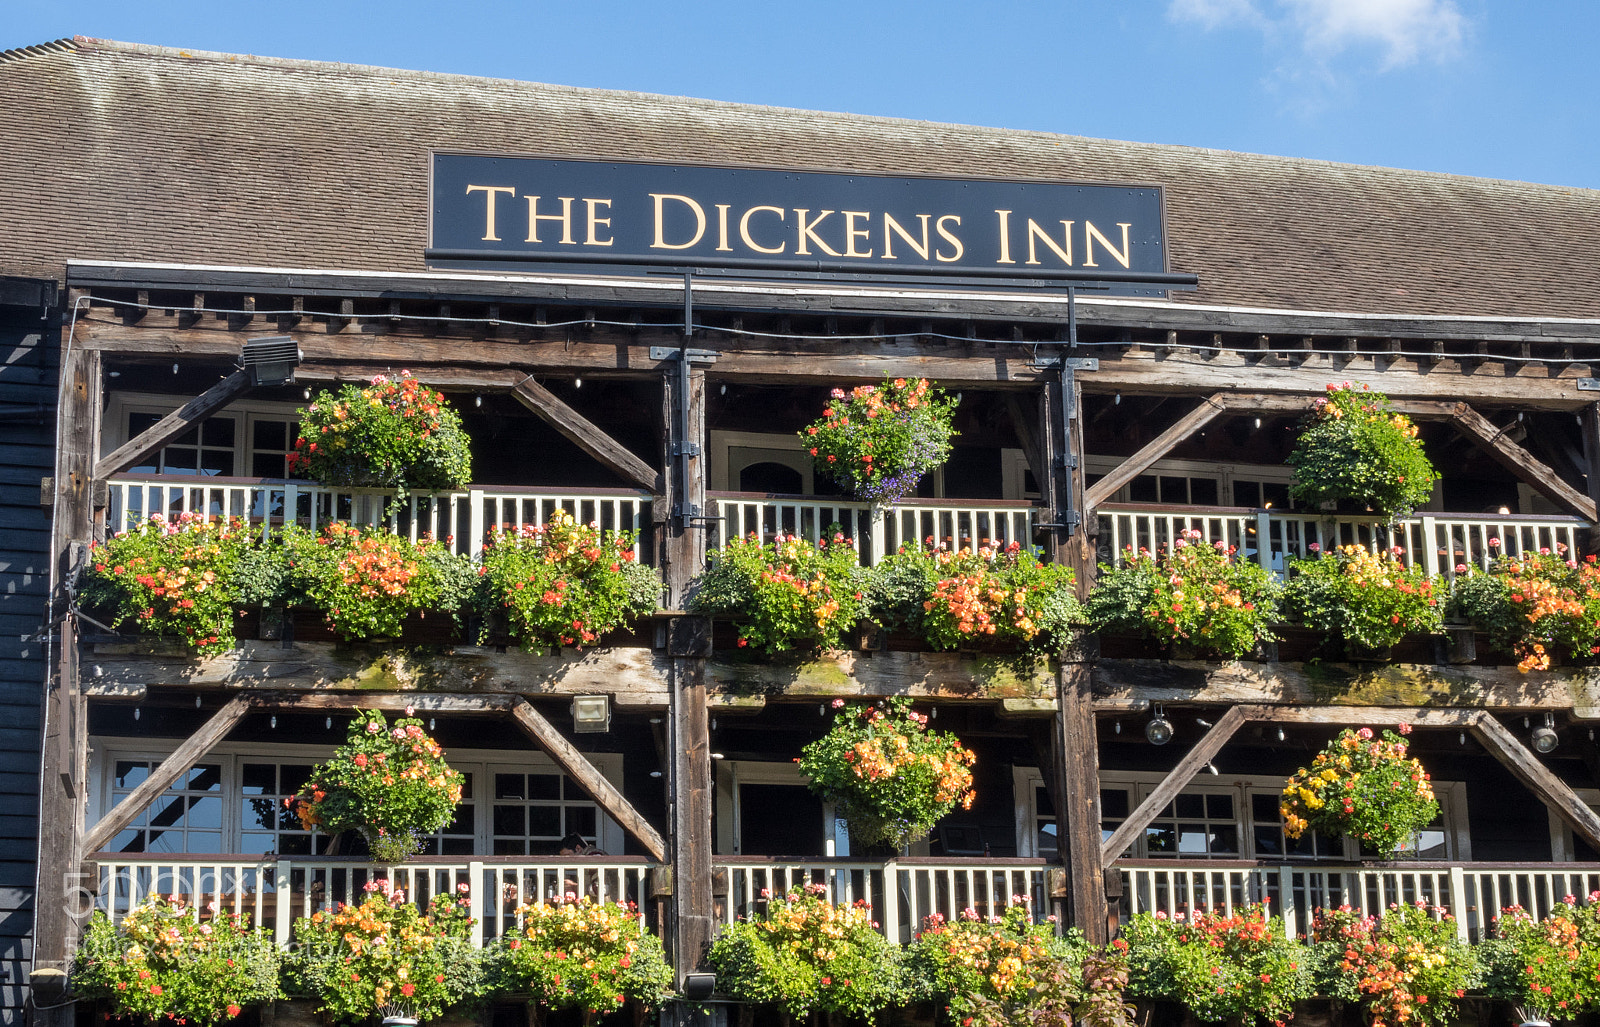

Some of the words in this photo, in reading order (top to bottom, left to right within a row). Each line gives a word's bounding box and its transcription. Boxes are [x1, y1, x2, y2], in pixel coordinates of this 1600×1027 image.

[465, 184, 614, 247] THE
[649, 193, 964, 263] DICKENS
[995, 209, 1132, 269] INN
